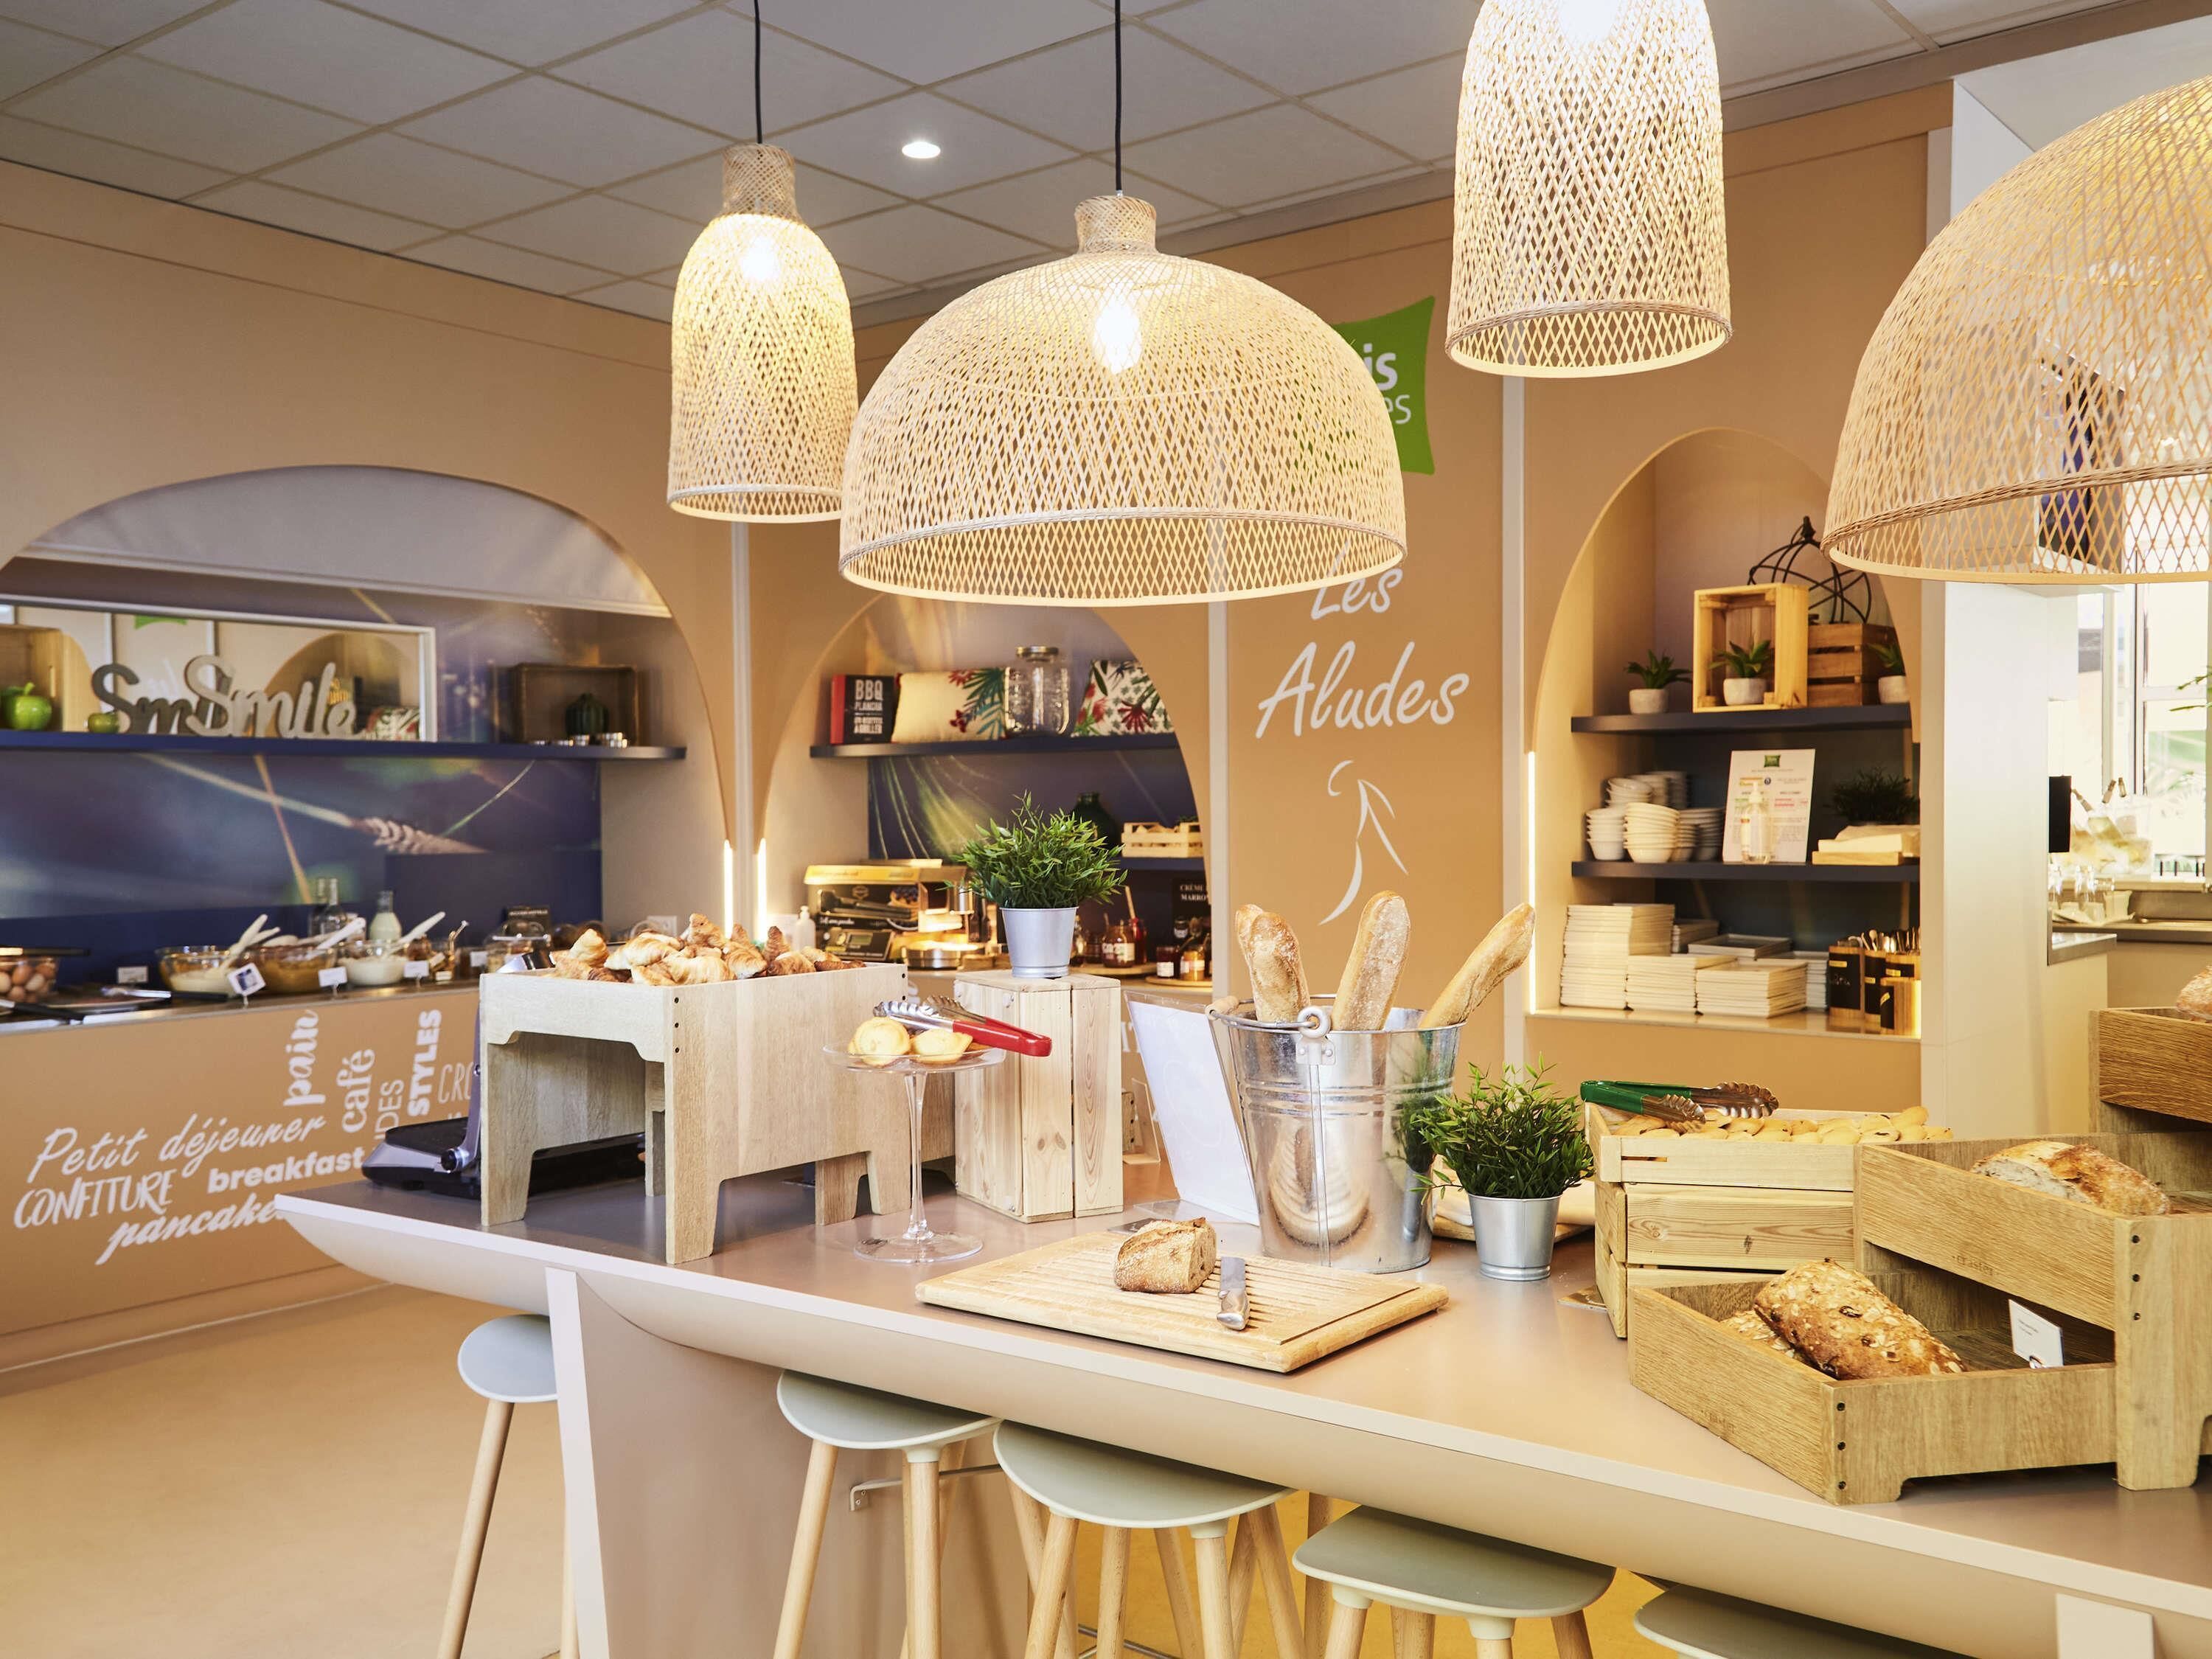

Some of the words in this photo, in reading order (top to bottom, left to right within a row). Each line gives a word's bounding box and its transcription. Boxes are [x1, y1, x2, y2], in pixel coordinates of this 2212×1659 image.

[1363, 343, 1398, 392] is
[1311, 542, 1403, 619] Les
[184, 654, 366, 739] Smile
[855, 679, 883, 701] BBQ
[1256, 640, 1470, 739] Aludes
[283, 1009, 326, 1106] pain
[336, 1048, 375, 1133] café
[408, 1009, 442, 1117] STYLES
[27, 1127, 148, 1183] Petit
[159, 1113, 326, 1178] déjeuner
[207, 1147, 365, 1194] breakfast
[13, 1169, 176, 1229] CONFITURE
[94, 1192, 284, 1265] pancake
